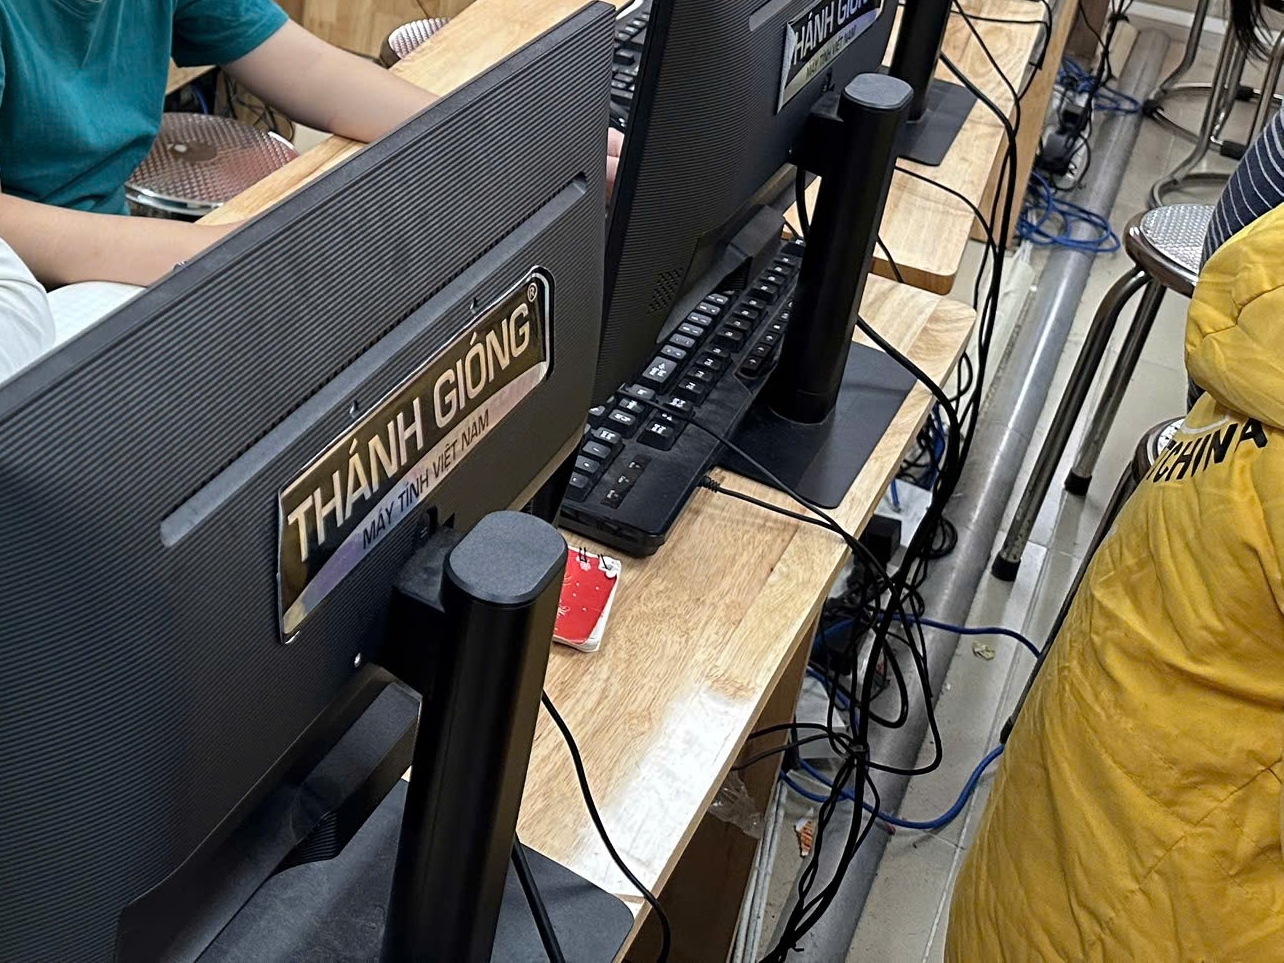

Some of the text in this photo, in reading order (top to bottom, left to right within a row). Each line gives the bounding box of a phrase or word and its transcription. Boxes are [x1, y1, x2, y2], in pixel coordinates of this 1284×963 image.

[793, 1, 834, 65] HÁNH
[287, 397, 424, 562] THÁNH
[433, 302, 531, 429] GIÓNG
[362, 408, 490, 549] MÁY TÍNH VIỆT NAM
